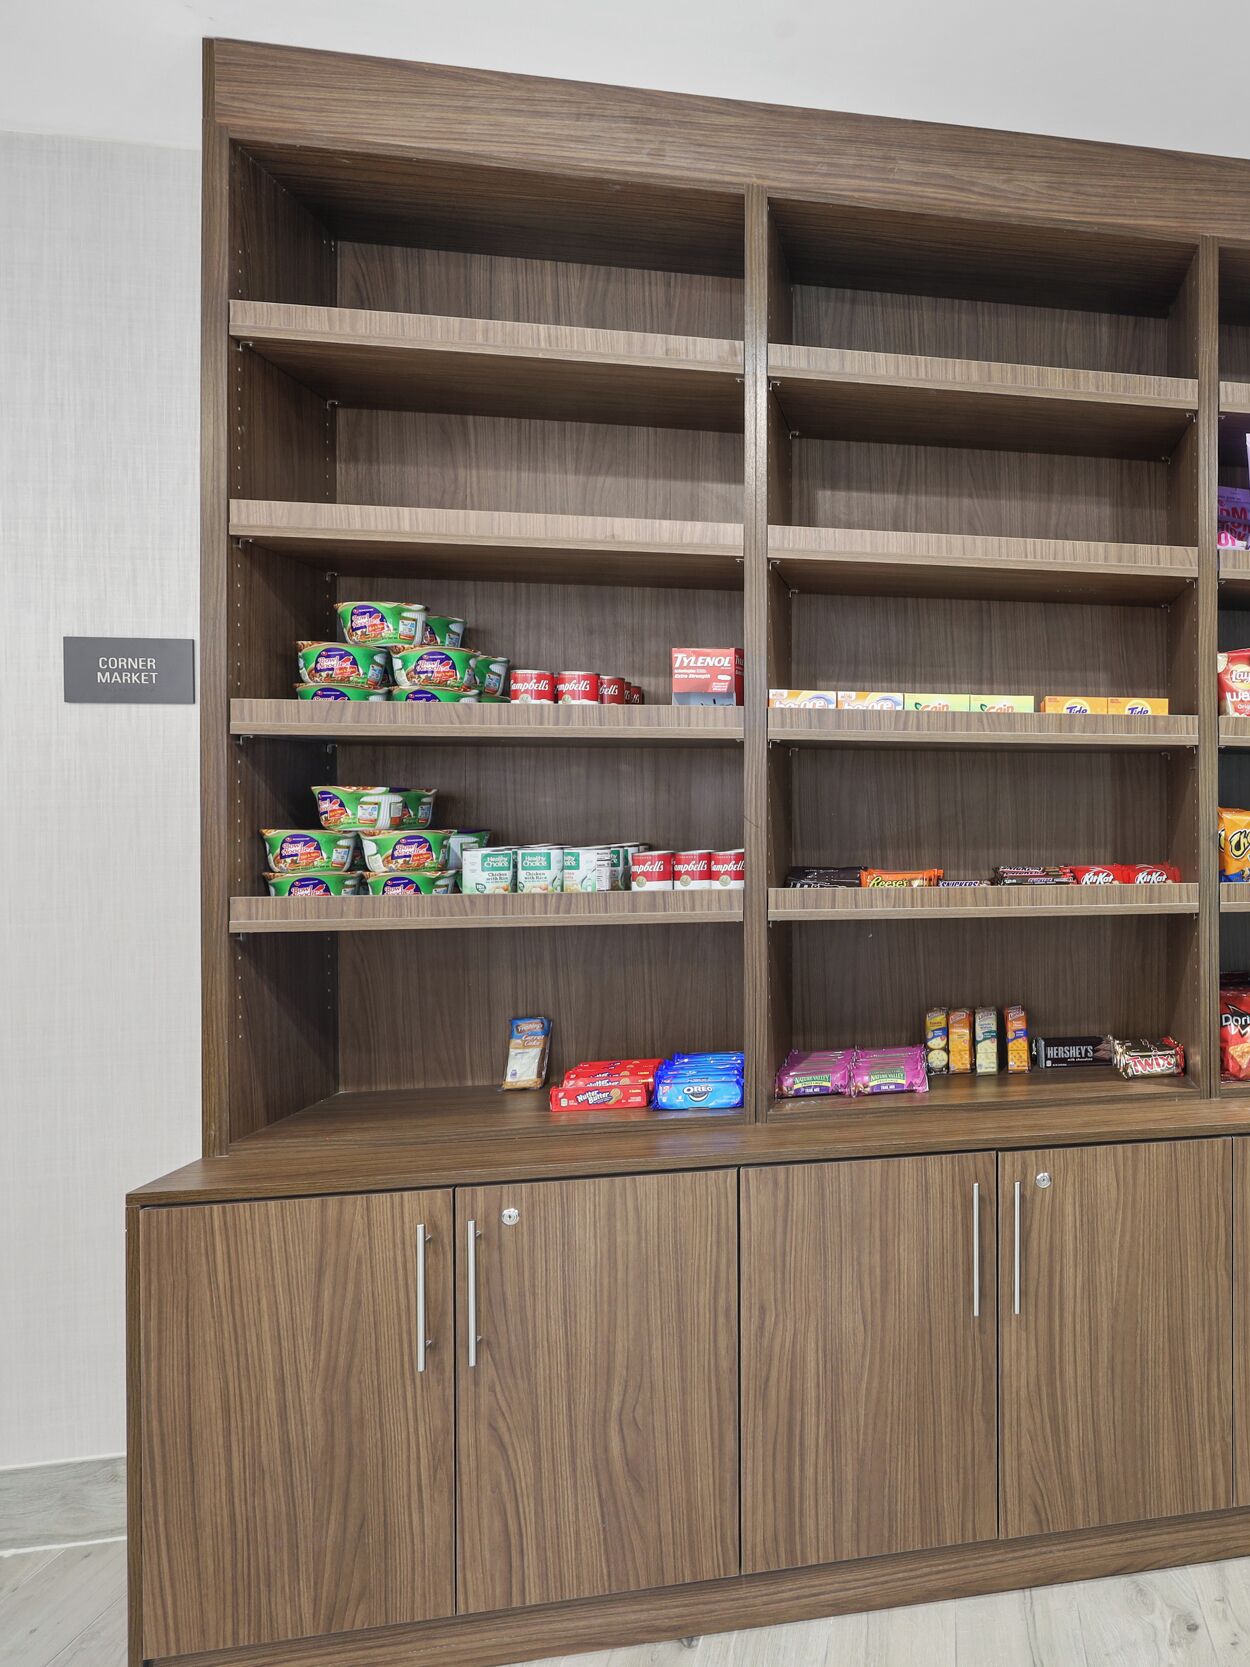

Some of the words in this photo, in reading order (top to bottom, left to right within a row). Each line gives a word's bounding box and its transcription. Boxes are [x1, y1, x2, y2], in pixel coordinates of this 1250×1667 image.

[98, 656, 157, 670] CORNER
[673, 653, 733, 668] TYLENOL
[96, 672, 158, 685] MARKET
[1047, 1045, 1093, 1059] HERSHEY'S
[1127, 1055, 1173, 1073] TWIX
[794, 1076, 812, 1084] NATURE
[813, 1074, 830, 1082] VALLEY
[871, 1073, 887, 1081] NATURE
[887, 1072, 904, 1080] VALLEY
[577, 1090, 600, 1103] Nutter
[588, 1091, 610, 1104] Butter
